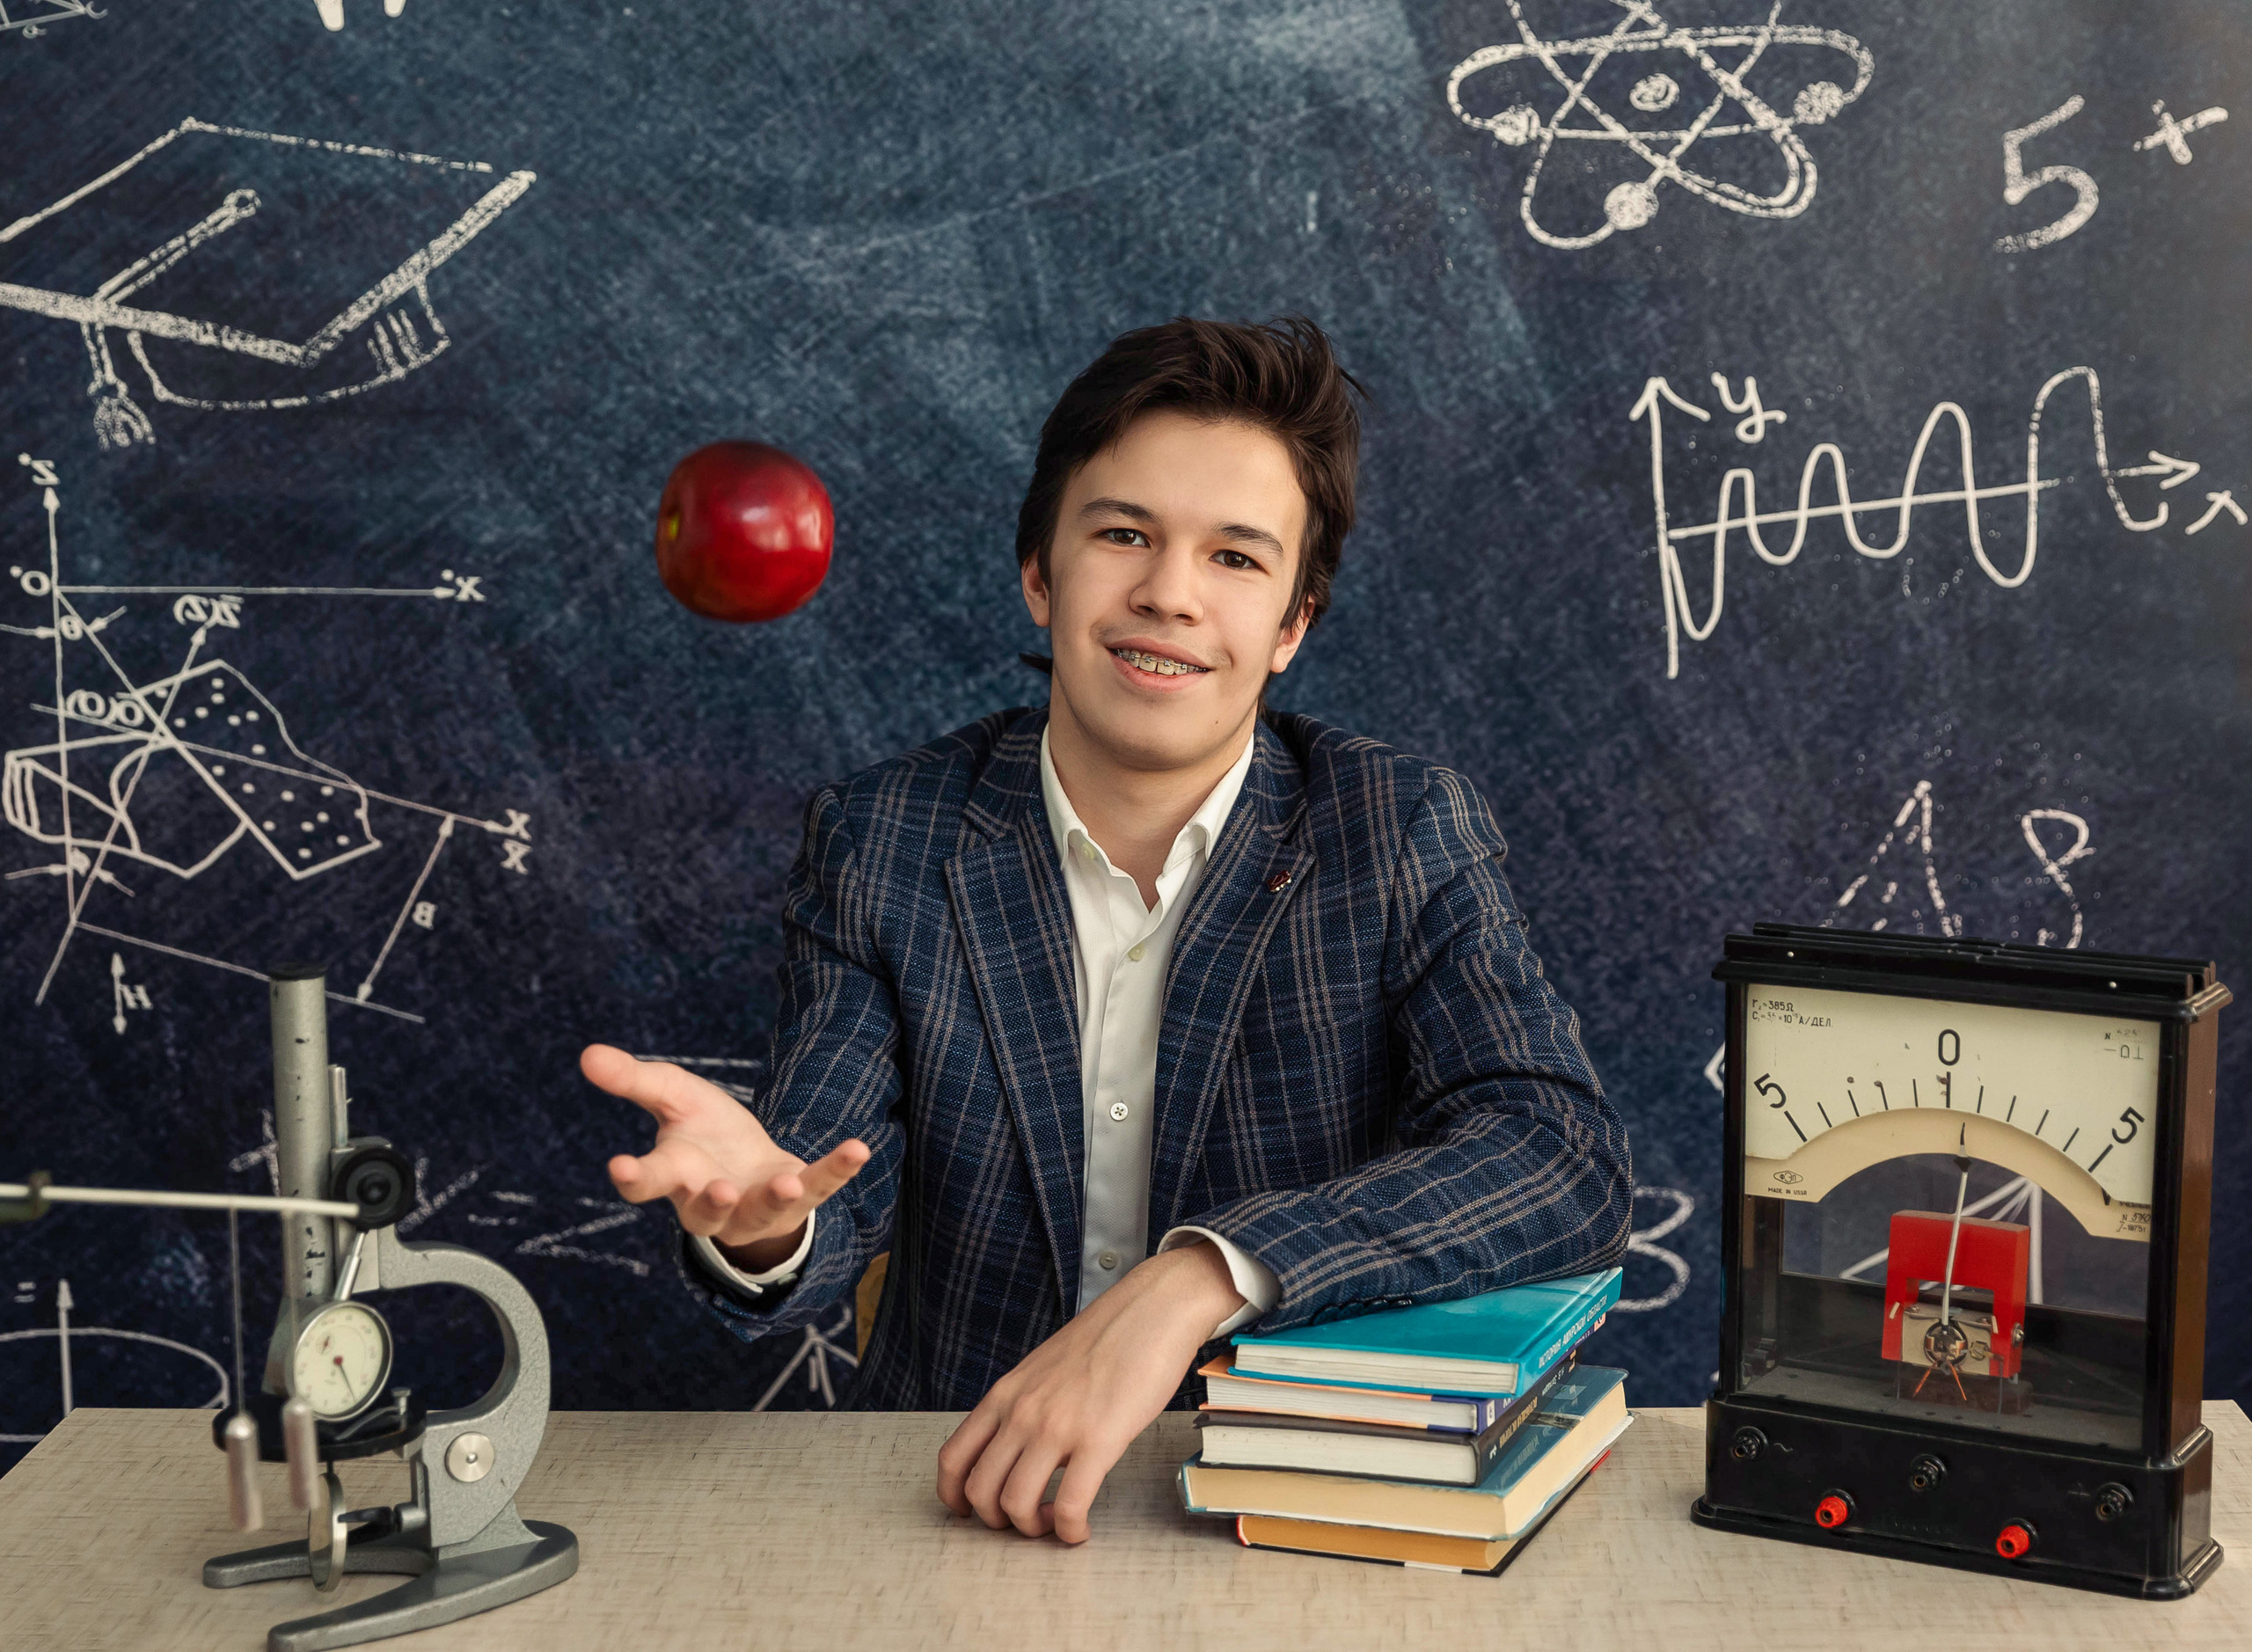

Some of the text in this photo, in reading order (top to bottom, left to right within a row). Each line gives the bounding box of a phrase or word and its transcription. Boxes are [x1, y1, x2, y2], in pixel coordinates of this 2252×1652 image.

[1938, 1029, 1961, 1066] 0
[1754, 1073, 1788, 1108] 5
[2111, 1107, 2145, 1144] 5
[1539, 1339, 1561, 1369] ИСТОРИЯ
[1562, 1312, 1587, 1347] АМУРСКОЙ
[1587, 1294, 1608, 1322] ОБЛАСТИ
